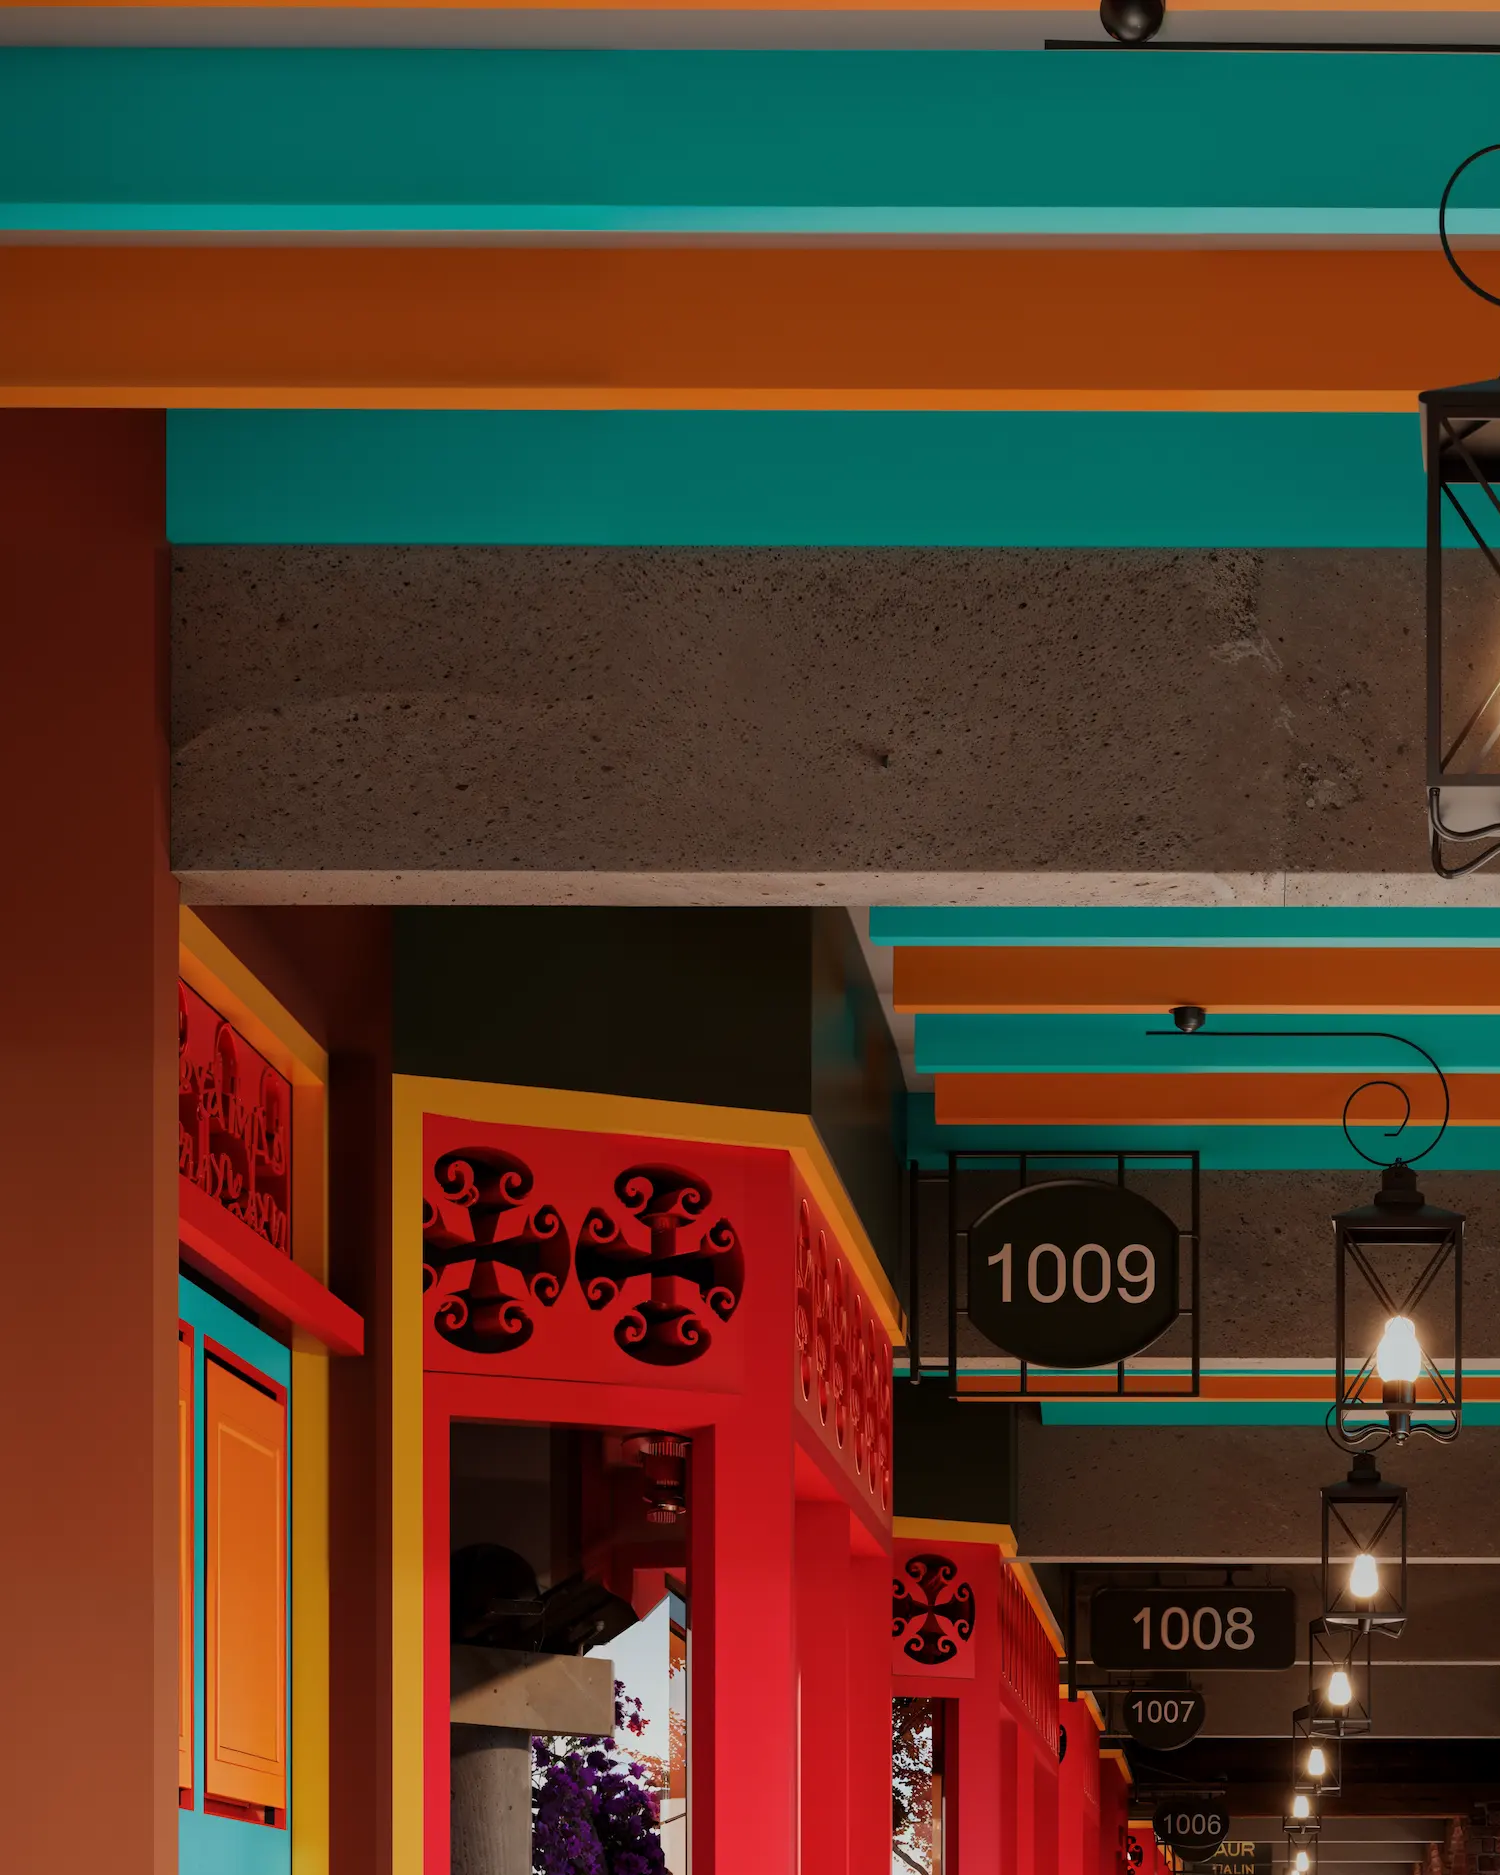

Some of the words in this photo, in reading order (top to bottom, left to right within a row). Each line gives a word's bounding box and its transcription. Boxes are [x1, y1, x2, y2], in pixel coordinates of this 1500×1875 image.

[987, 1243, 1156, 1303] 1009
[1133, 1606, 1255, 1651] 1008
[1132, 1700, 1196, 1723] 1007
[1163, 1813, 1222, 1835] 1006
